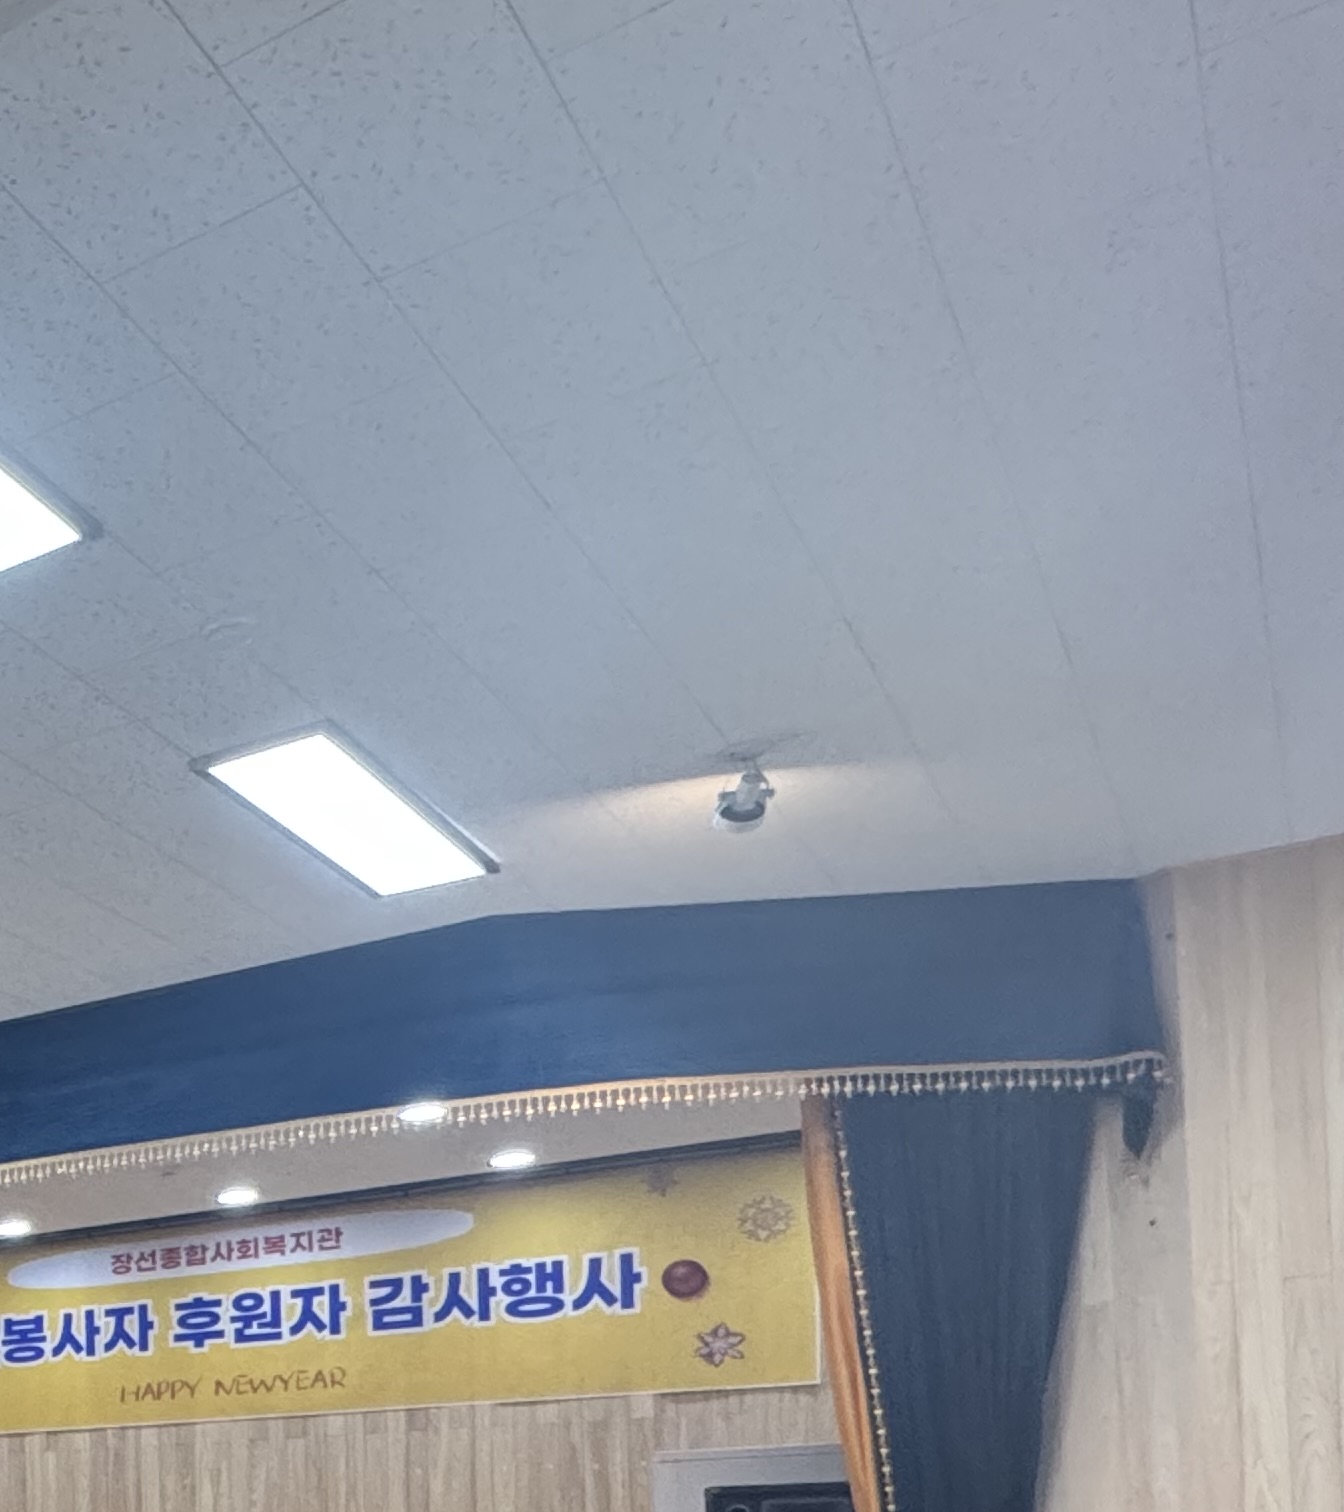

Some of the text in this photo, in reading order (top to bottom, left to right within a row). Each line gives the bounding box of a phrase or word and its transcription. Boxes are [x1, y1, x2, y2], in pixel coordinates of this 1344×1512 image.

[110, 1226, 344, 1276] 장선종합사회복지관
[172, 1283, 348, 1349] 후원자
[368, 1252, 643, 1332] 감사행사
[119, 1374, 203, 1404] HAPPY
